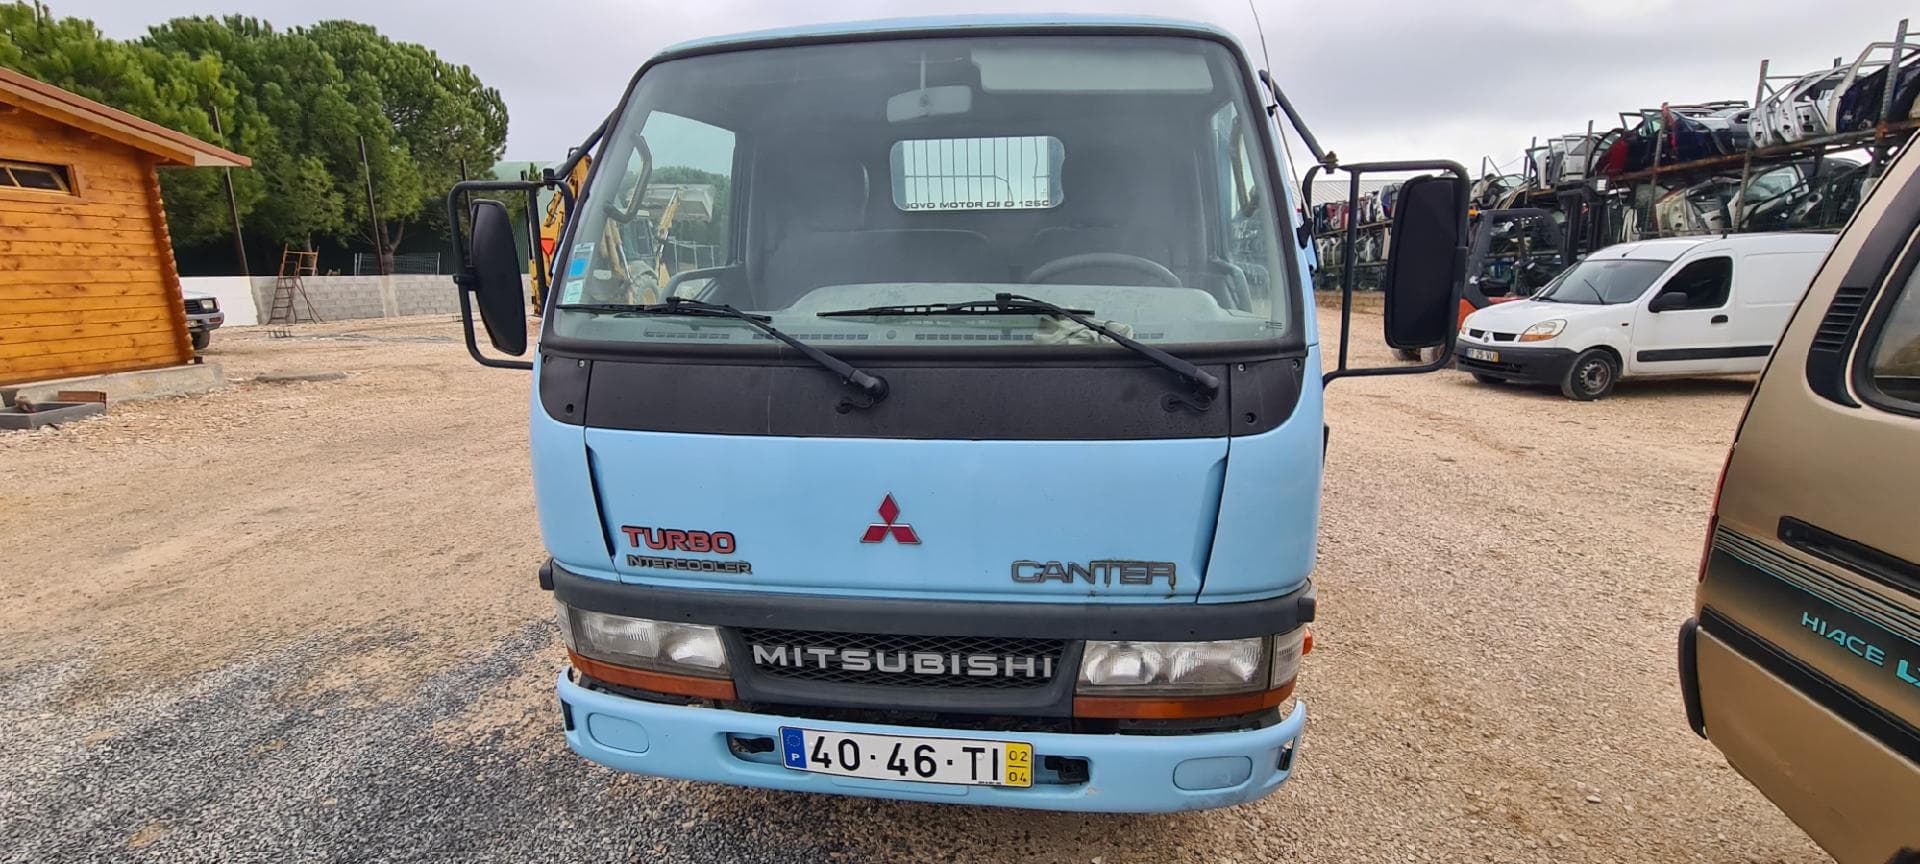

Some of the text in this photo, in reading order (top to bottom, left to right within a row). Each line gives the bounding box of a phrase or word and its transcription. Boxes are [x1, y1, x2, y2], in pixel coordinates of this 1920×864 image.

[621, 525, 736, 554] TURBO
[626, 554, 753, 575] INTERCOOLER
[1011, 560, 1176, 587] CANTER
[1801, 611, 1885, 667] HIACE
[752, 644, 1052, 678] MITSUBISHI
[791, 753, 801, 761] P
[1008, 750, 1028, 762] 02
[1008, 771, 1027, 783] 04
